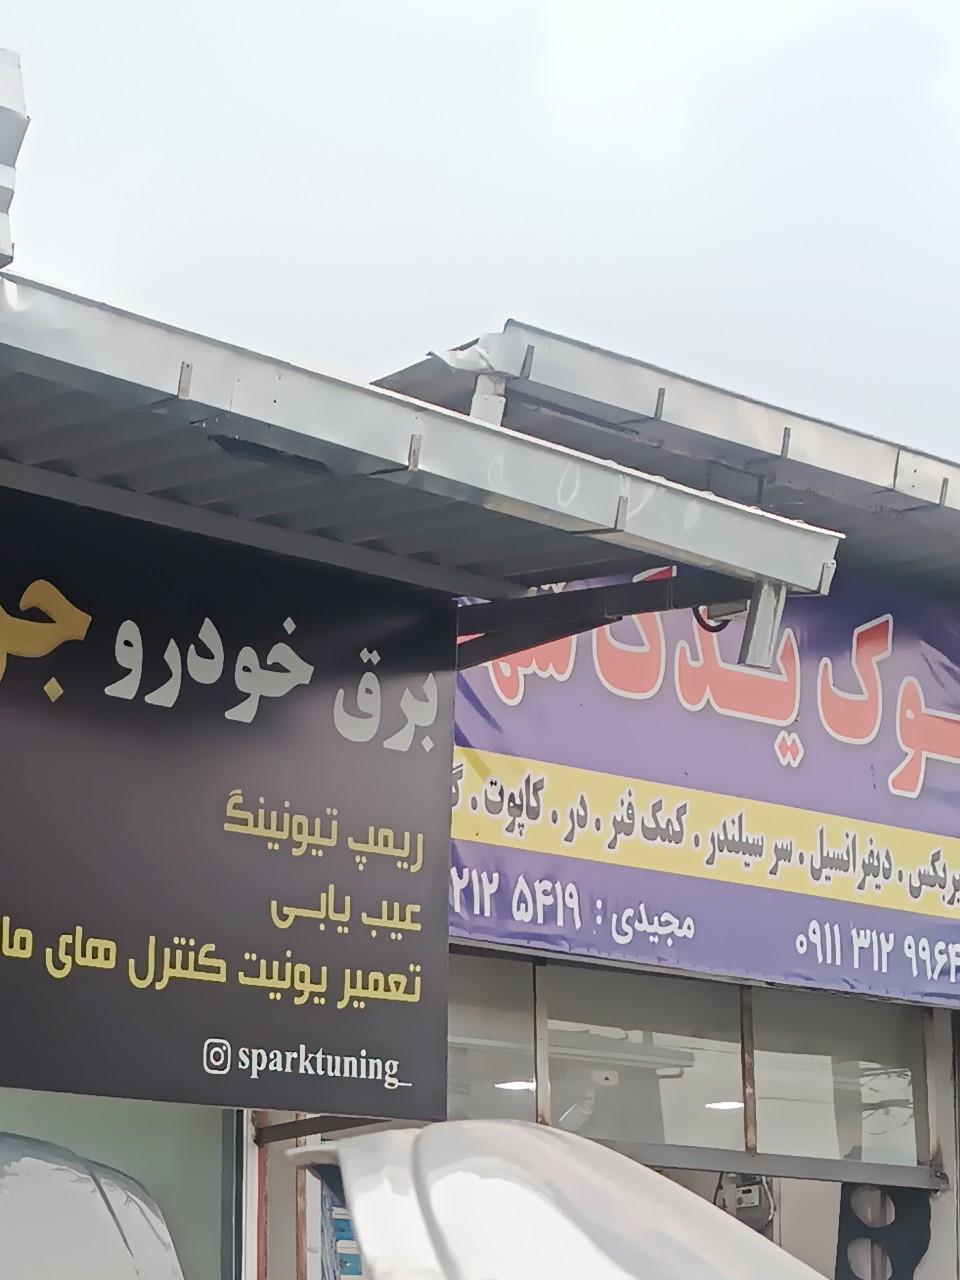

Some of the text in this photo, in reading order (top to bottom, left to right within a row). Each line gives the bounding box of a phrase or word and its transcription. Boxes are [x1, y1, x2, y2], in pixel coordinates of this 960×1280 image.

[104, 616, 315, 724] خودرو
[333, 647, 438, 752] برق
[224, 788, 425, 872] ریمپ تیونینگ
[484, 773, 545, 837] کاپوت
[563, 793, 588, 843] در
[607, 788, 636, 850] فنر
[641, 799, 688, 845] کمک
[705, 812, 764, 868] سیلندر
[270, 883, 423, 941] عیب یابی
[511, 873, 582, 931] ۵۴۱۹
[45, 926, 117, 979] های
[128, 935, 227, 990] کنترل
[795, 919, 842, 966] ۰۹۱۱
[851, 926, 895, 973] ۳۱۲
[238, 949, 328, 1005] یونیت
[337, 962, 423, 1010] تعمیر
